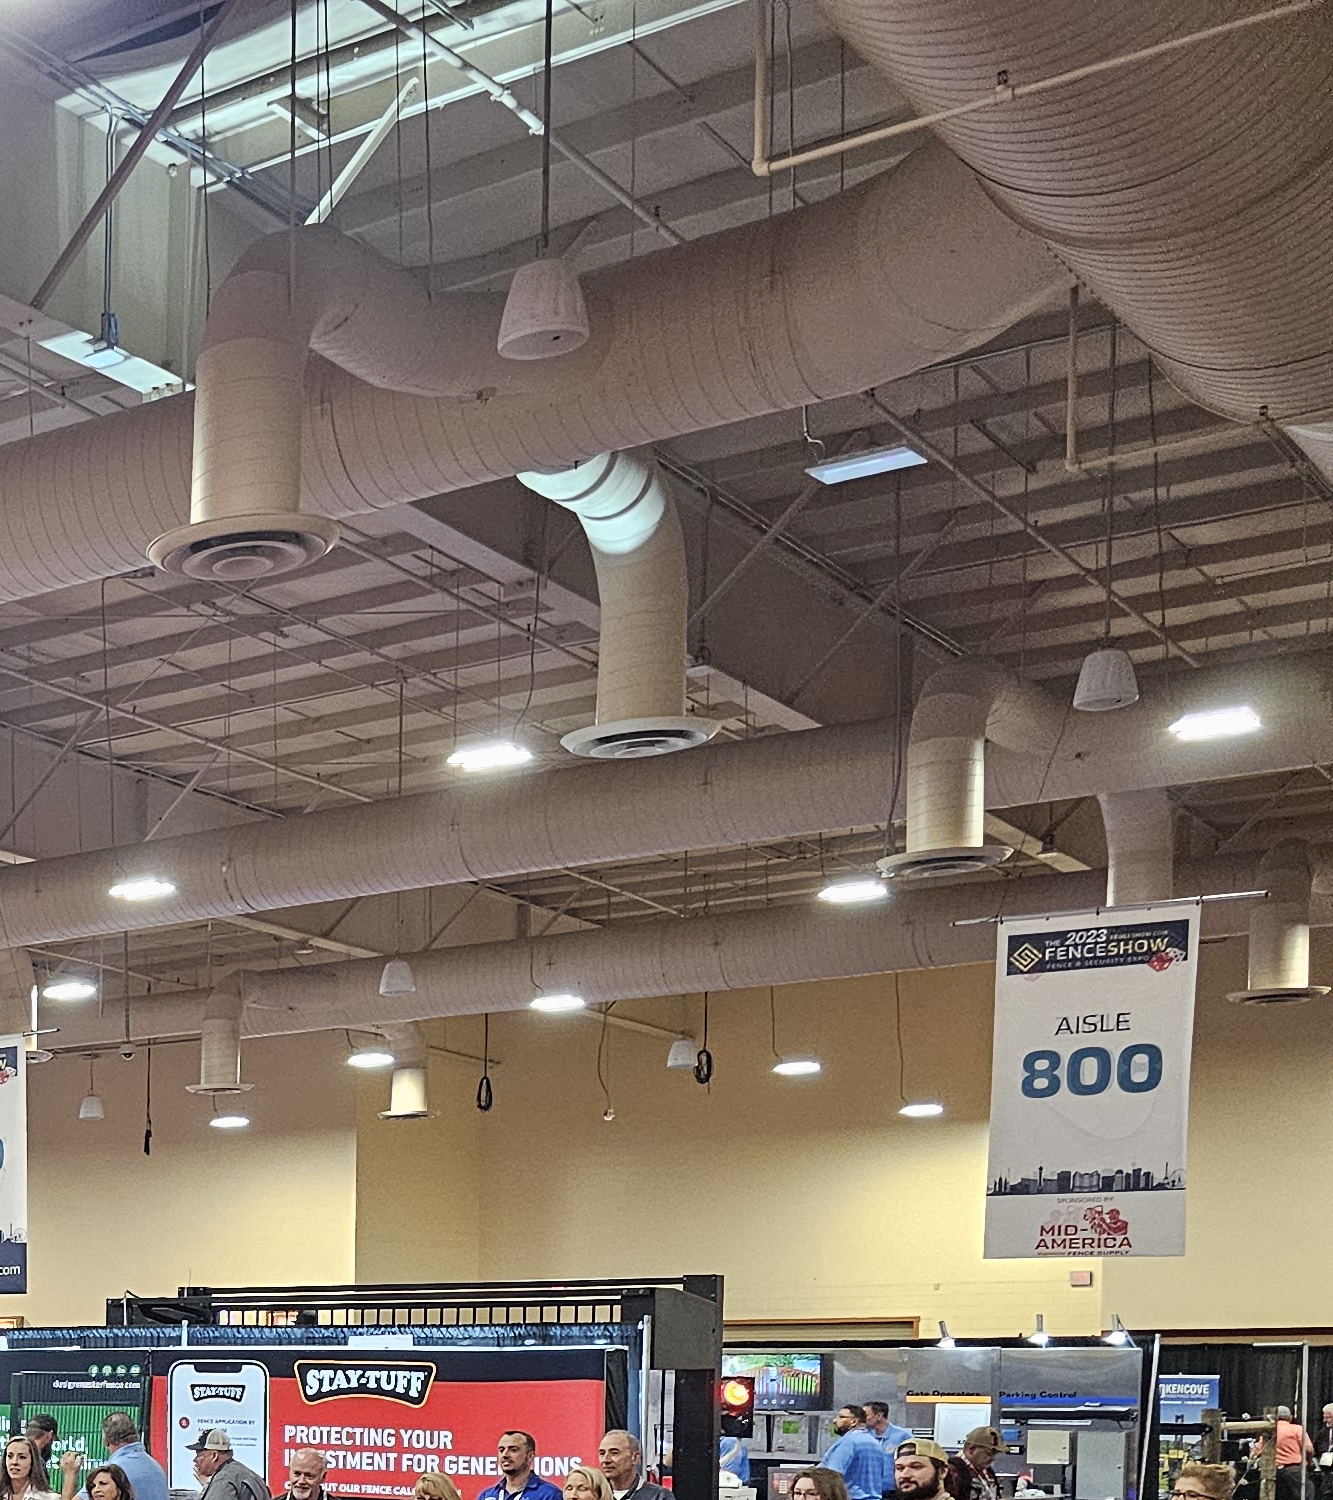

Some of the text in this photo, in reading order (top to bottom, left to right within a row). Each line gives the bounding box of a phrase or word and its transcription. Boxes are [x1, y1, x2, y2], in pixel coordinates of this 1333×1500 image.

[1065, 929, 1107, 945] 2023
[1045, 938, 1169, 961] FENCESHOW
[1084, 957, 1125, 967] SECURITY
[1054, 1012, 1132, 1035] AISLE
[1021, 1043, 1163, 1098] 800
[1040, 1225, 1088, 1236] MID-
[1035, 1237, 1132, 1249] AMERICA
[305, 1369, 425, 1398] STAY-TUFF
[1166, 1384, 1209, 1394] KENCOVE
[194, 1387, 242, 1399] STAY-TUFF
[285, 1425, 452, 1450] PROTECTING YOUR
[401, 1453, 439, 1474] FOR
